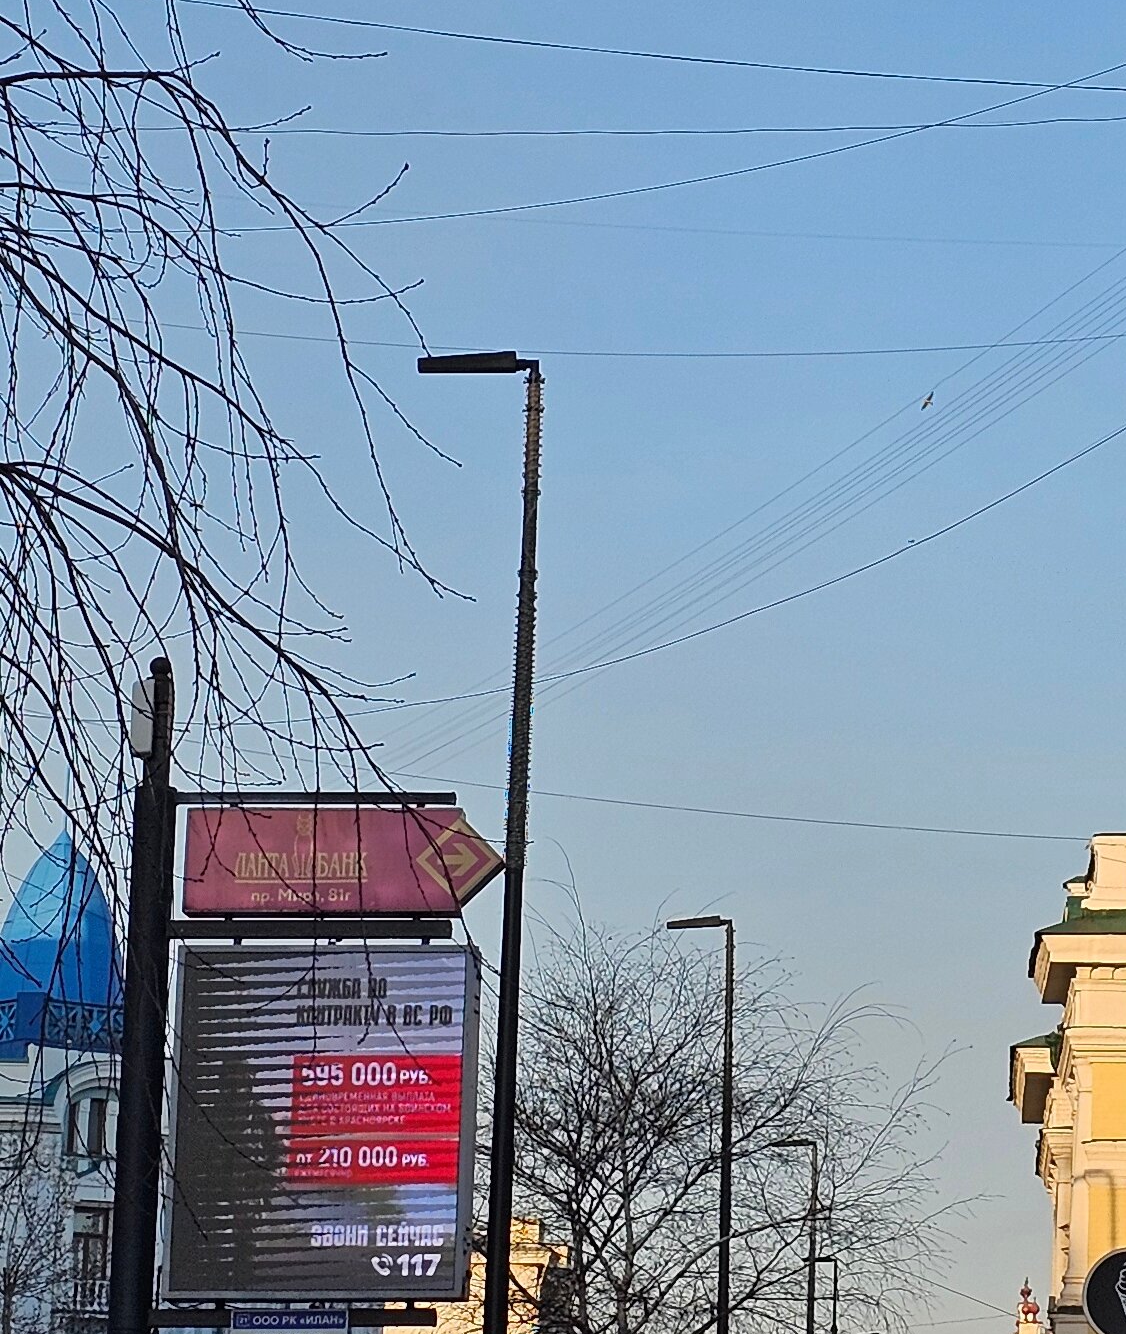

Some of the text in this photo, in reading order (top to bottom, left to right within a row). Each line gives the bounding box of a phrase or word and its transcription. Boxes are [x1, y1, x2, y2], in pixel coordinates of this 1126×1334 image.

[318, 852, 368, 877] БАНК
[251, 891, 275, 904] пр.
[328, 888, 351, 902] 81г
[386, 1005, 397, 1026] В
[402, 1005, 423, 1026] ВС
[429, 1005, 453, 1026] РФ
[351, 1062, 397, 1086] 000
[400, 1069, 433, 1084] РУБ.
[318, 1146, 352, 1167] 210
[358, 1146, 398, 1167] 000
[375, 1222, 445, 1247] СЕЙЧАС
[396, 1253, 442, 1277] 117
[253, 1316, 279, 1325] ООО
[282, 1316, 297, 1325] РК
[300, 1315, 344, 1325] «ИЛАН»
